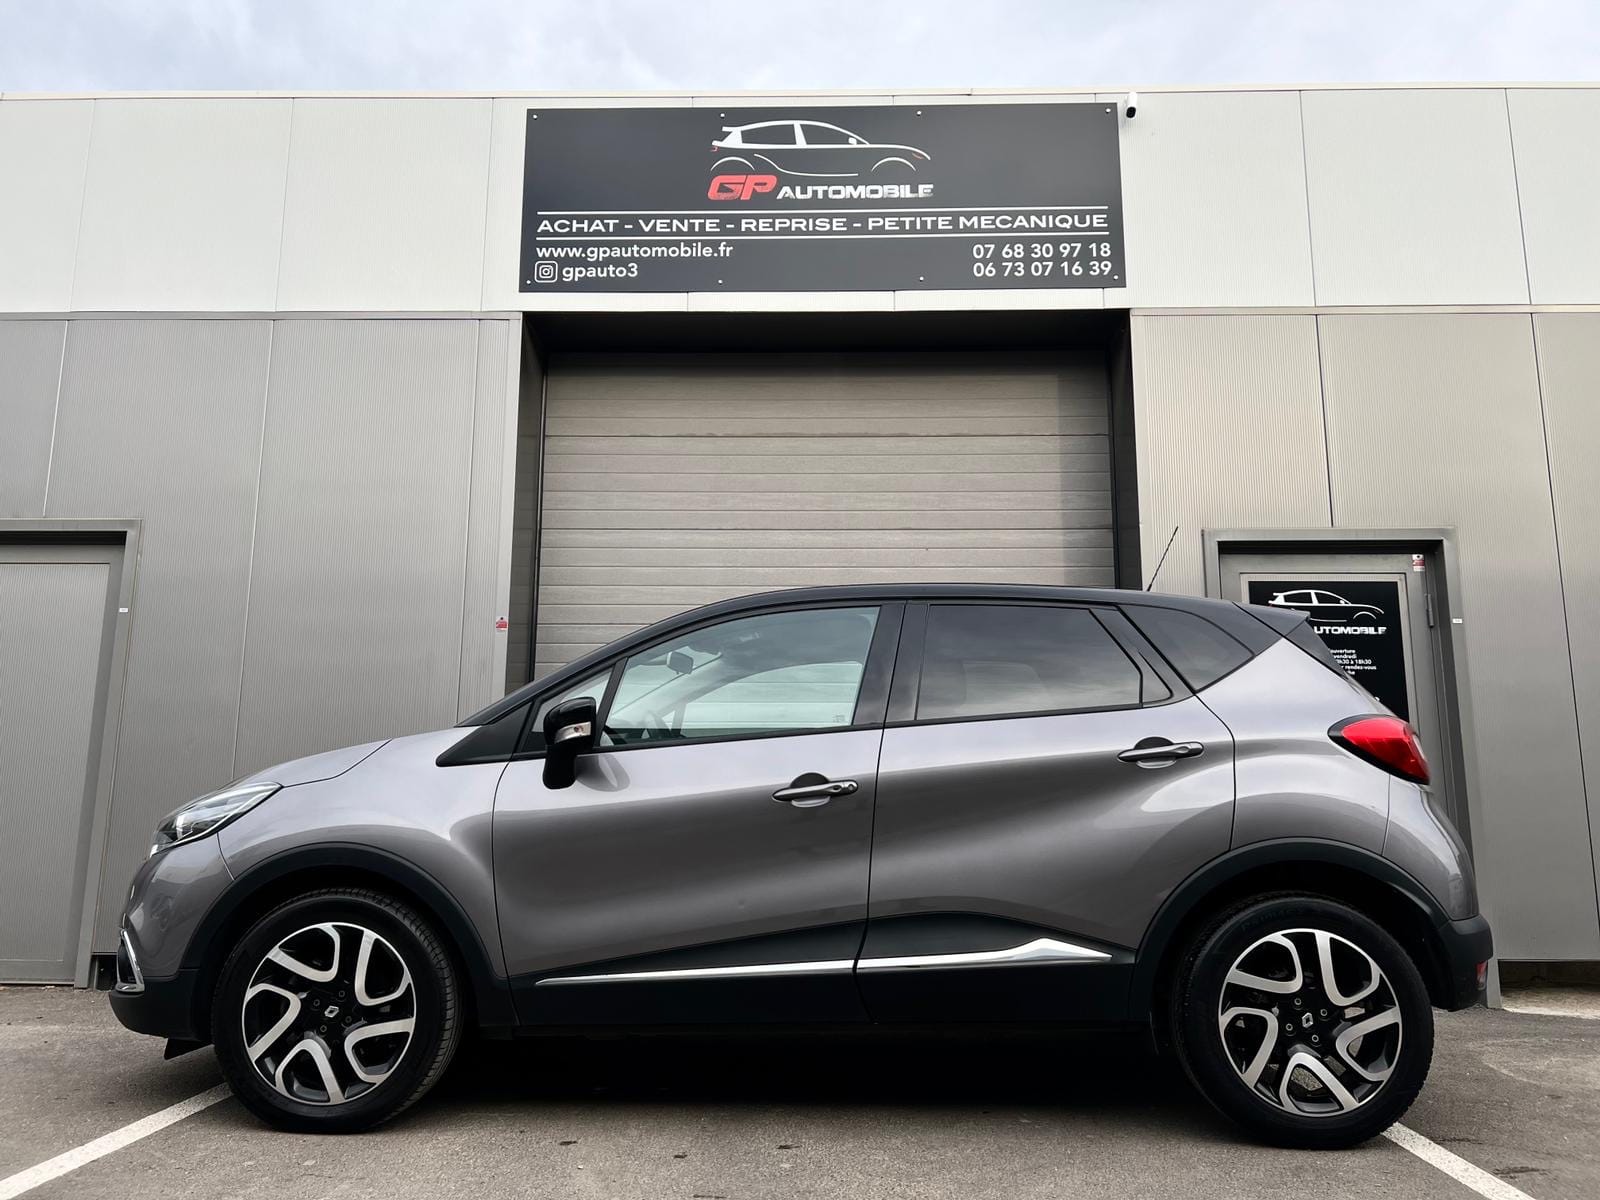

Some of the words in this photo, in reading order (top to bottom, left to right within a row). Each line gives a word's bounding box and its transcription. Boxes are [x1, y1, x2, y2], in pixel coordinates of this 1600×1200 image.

[707, 174, 778, 201] GP
[776, 183, 935, 200] AUTOMOBILE
[536, 218, 620, 233] ACHAT
[638, 218, 721, 233] VENTE
[740, 217, 848, 232] REPRISE
[867, 216, 954, 231] PETITE
[958, 214, 1109, 230] MECANIQUE
[535, 241, 734, 262] www.gpautomobile.fr
[972, 243, 996, 259] 07
[1001, 243, 1025, 259] 68
[1030, 242, 1054, 258] 30
[1059, 242, 1082, 258] 97
[1088, 242, 1112, 258] 18
[562, 262, 639, 282] gpauto3
[972, 262, 997, 278] 06
[1001, 261, 1025, 277] 73
[1030, 261, 1054, 277] 07
[1060, 260, 1084, 276] 16
[1088, 260, 1112, 276] 39
[1313, 625, 1387, 635] UTOMOBILE
